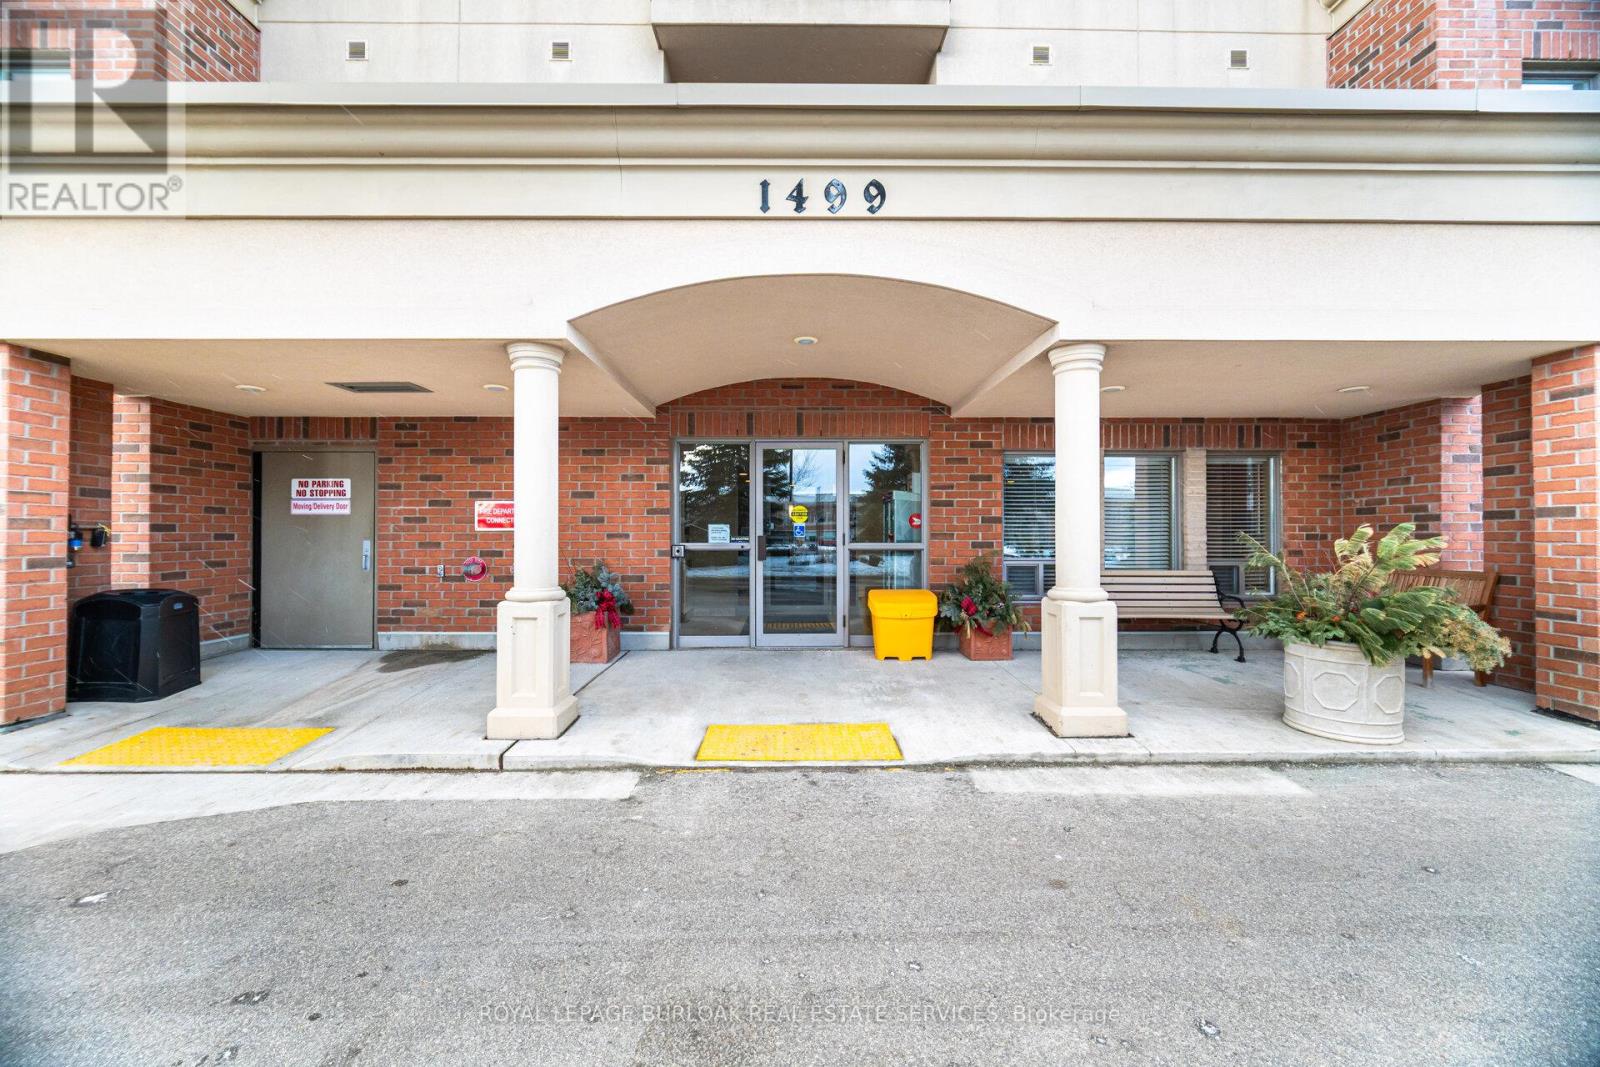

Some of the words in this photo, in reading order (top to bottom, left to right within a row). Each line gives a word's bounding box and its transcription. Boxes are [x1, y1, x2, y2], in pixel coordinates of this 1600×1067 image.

[759, 178, 886, 215] 1499
[298, 480, 309, 488] NO
[311, 480, 344, 488] PARKING
[296, 489, 307, 497] NO
[309, 489, 347, 497] STOPPING
[336, 502, 348, 510] Door
